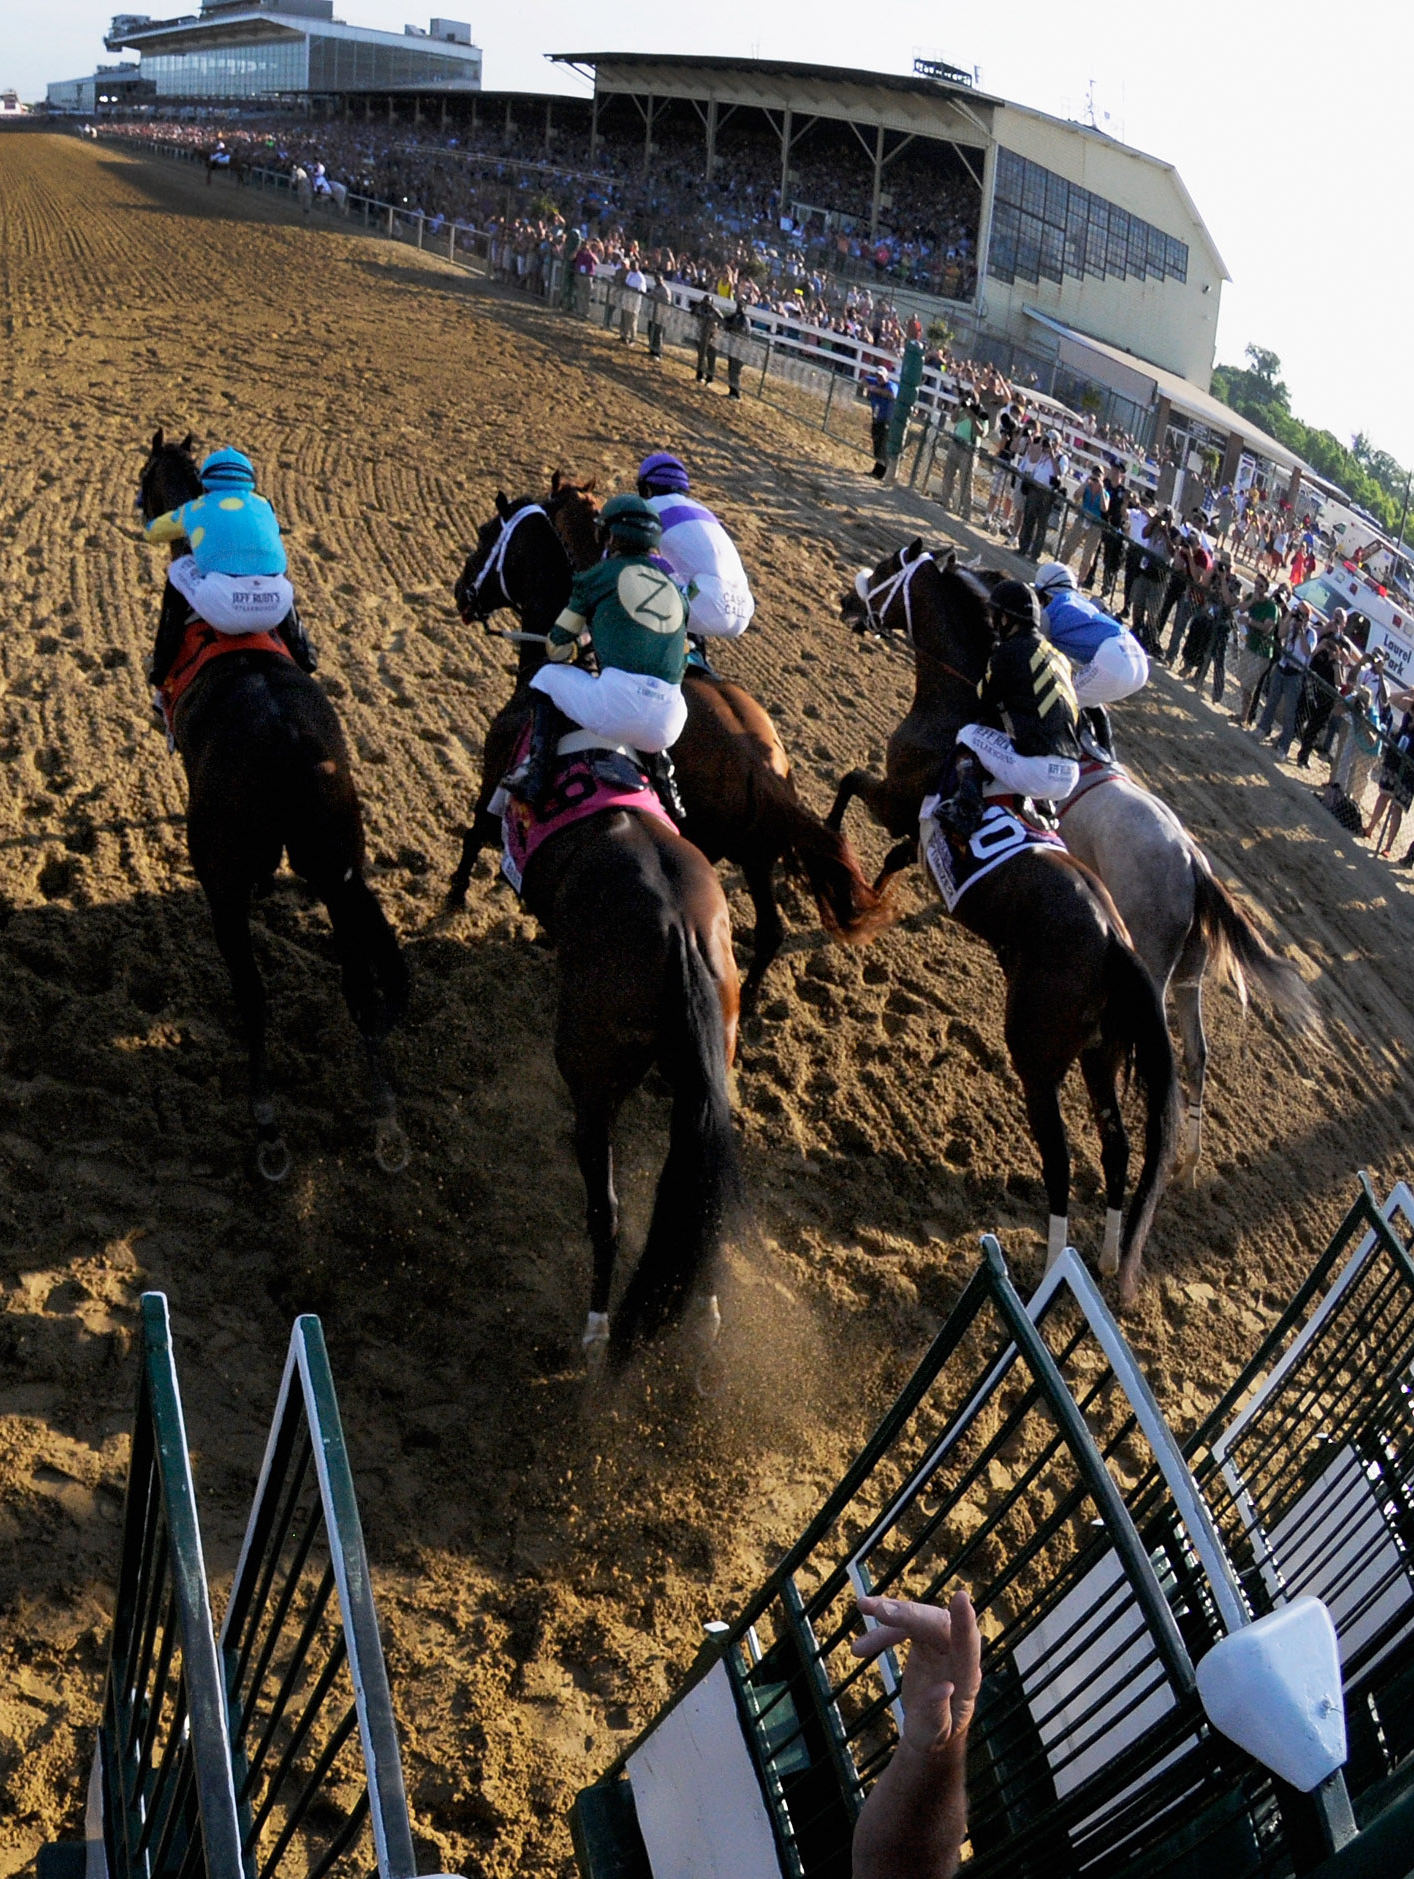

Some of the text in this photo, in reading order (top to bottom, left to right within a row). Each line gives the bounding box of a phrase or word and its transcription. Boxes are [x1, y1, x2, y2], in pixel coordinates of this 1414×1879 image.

[232, 592, 281, 604] JEFF RUBY'S
[635, 572, 672, 622] Z
[725, 604, 746, 619] CALL
[1382, 633, 1413, 665] Laurel
[1384, 651, 1405, 677] Park
[535, 773, 597, 823] 8
